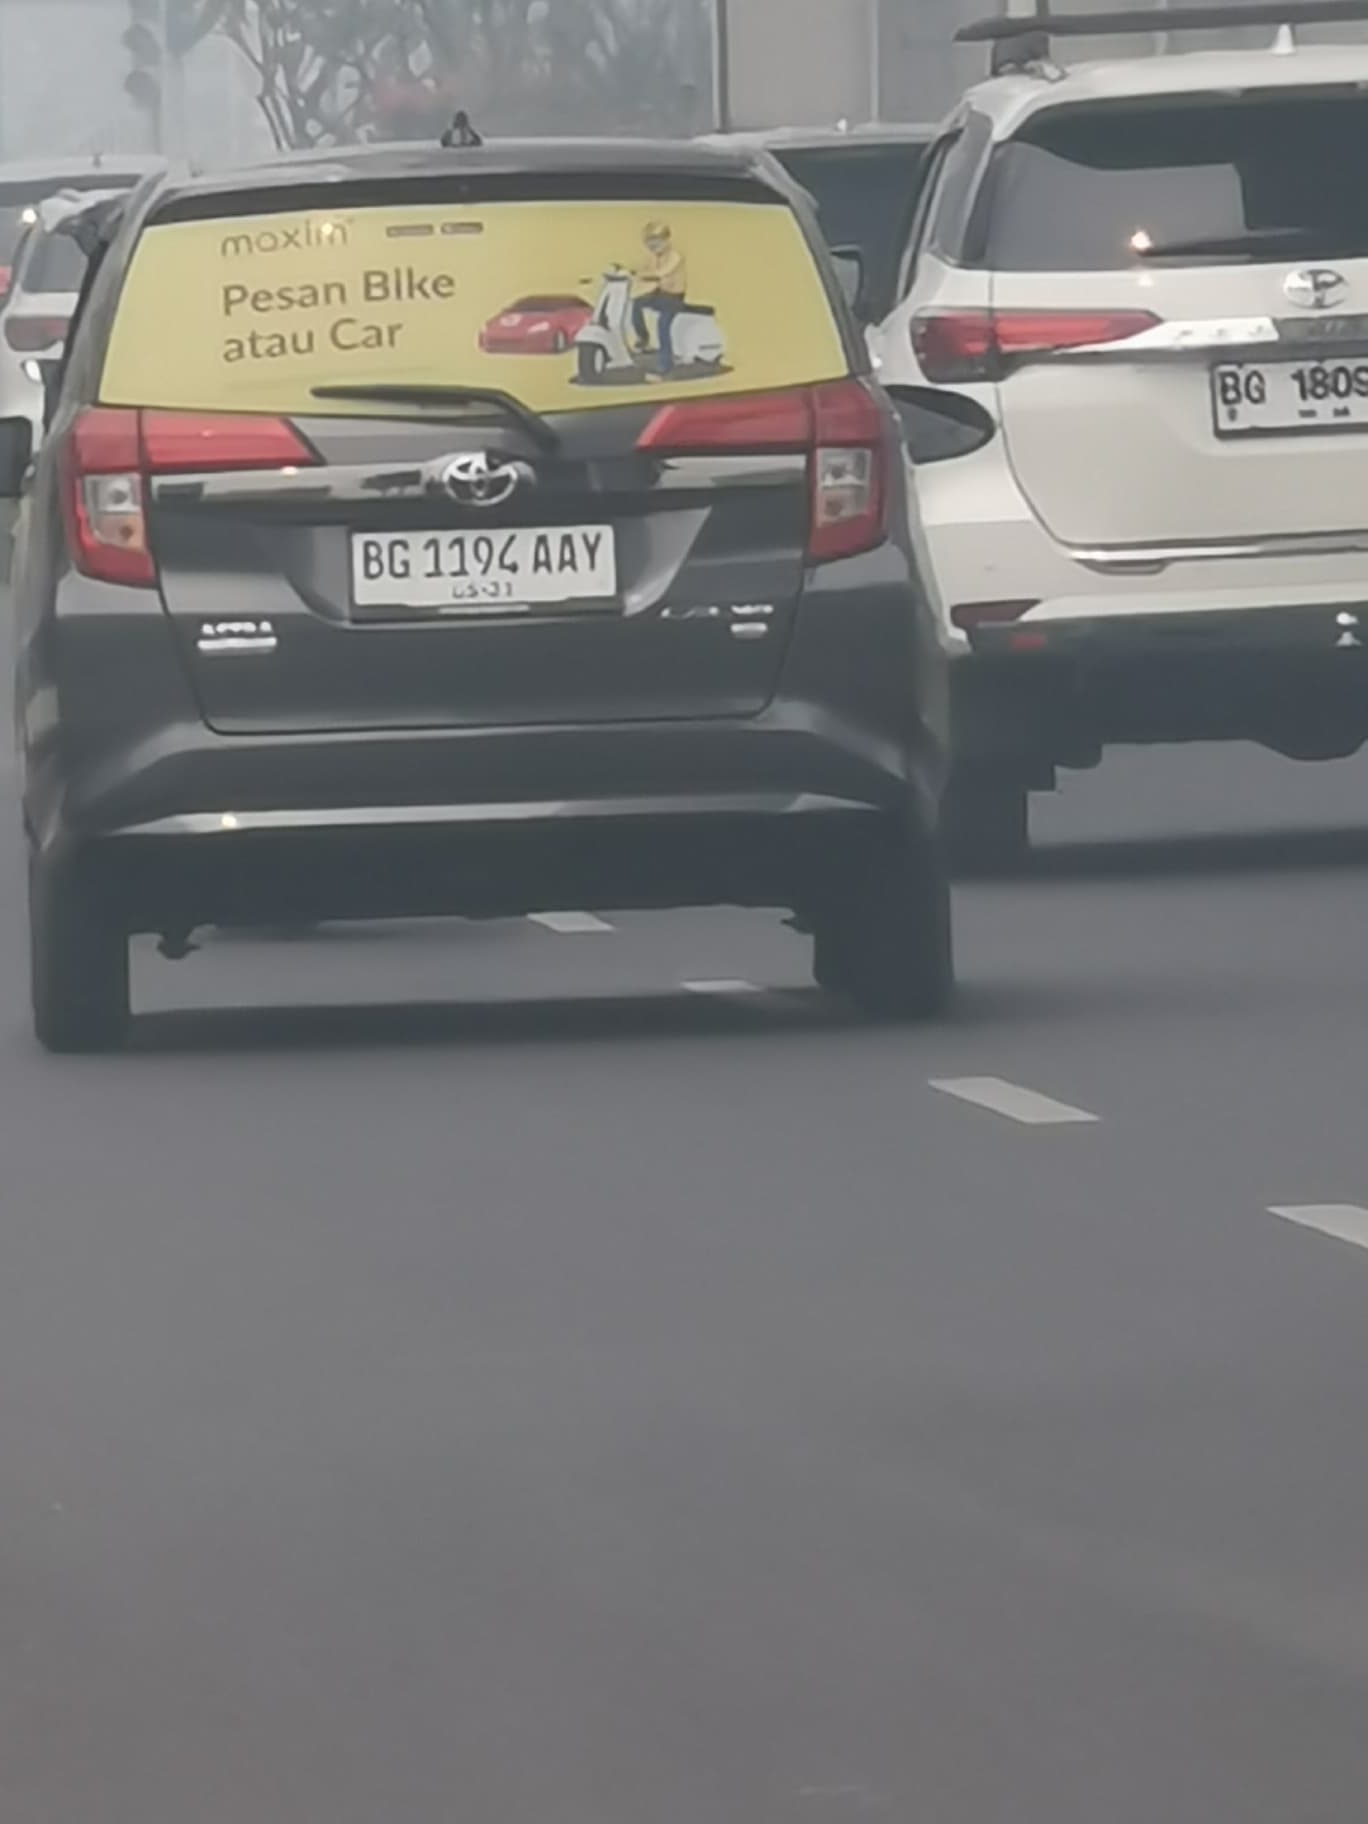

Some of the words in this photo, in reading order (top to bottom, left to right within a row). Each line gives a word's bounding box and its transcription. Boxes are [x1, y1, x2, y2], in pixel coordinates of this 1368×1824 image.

[221, 279, 348, 317] Pesan
[362, 265, 457, 303] Bike
[221, 327, 316, 364] atau
[328, 317, 405, 352] Car
[1219, 370, 1267, 407] BG
[362, 539, 410, 580] BG
[422, 533, 520, 578] 1194
[532, 530, 603, 576] AAY
